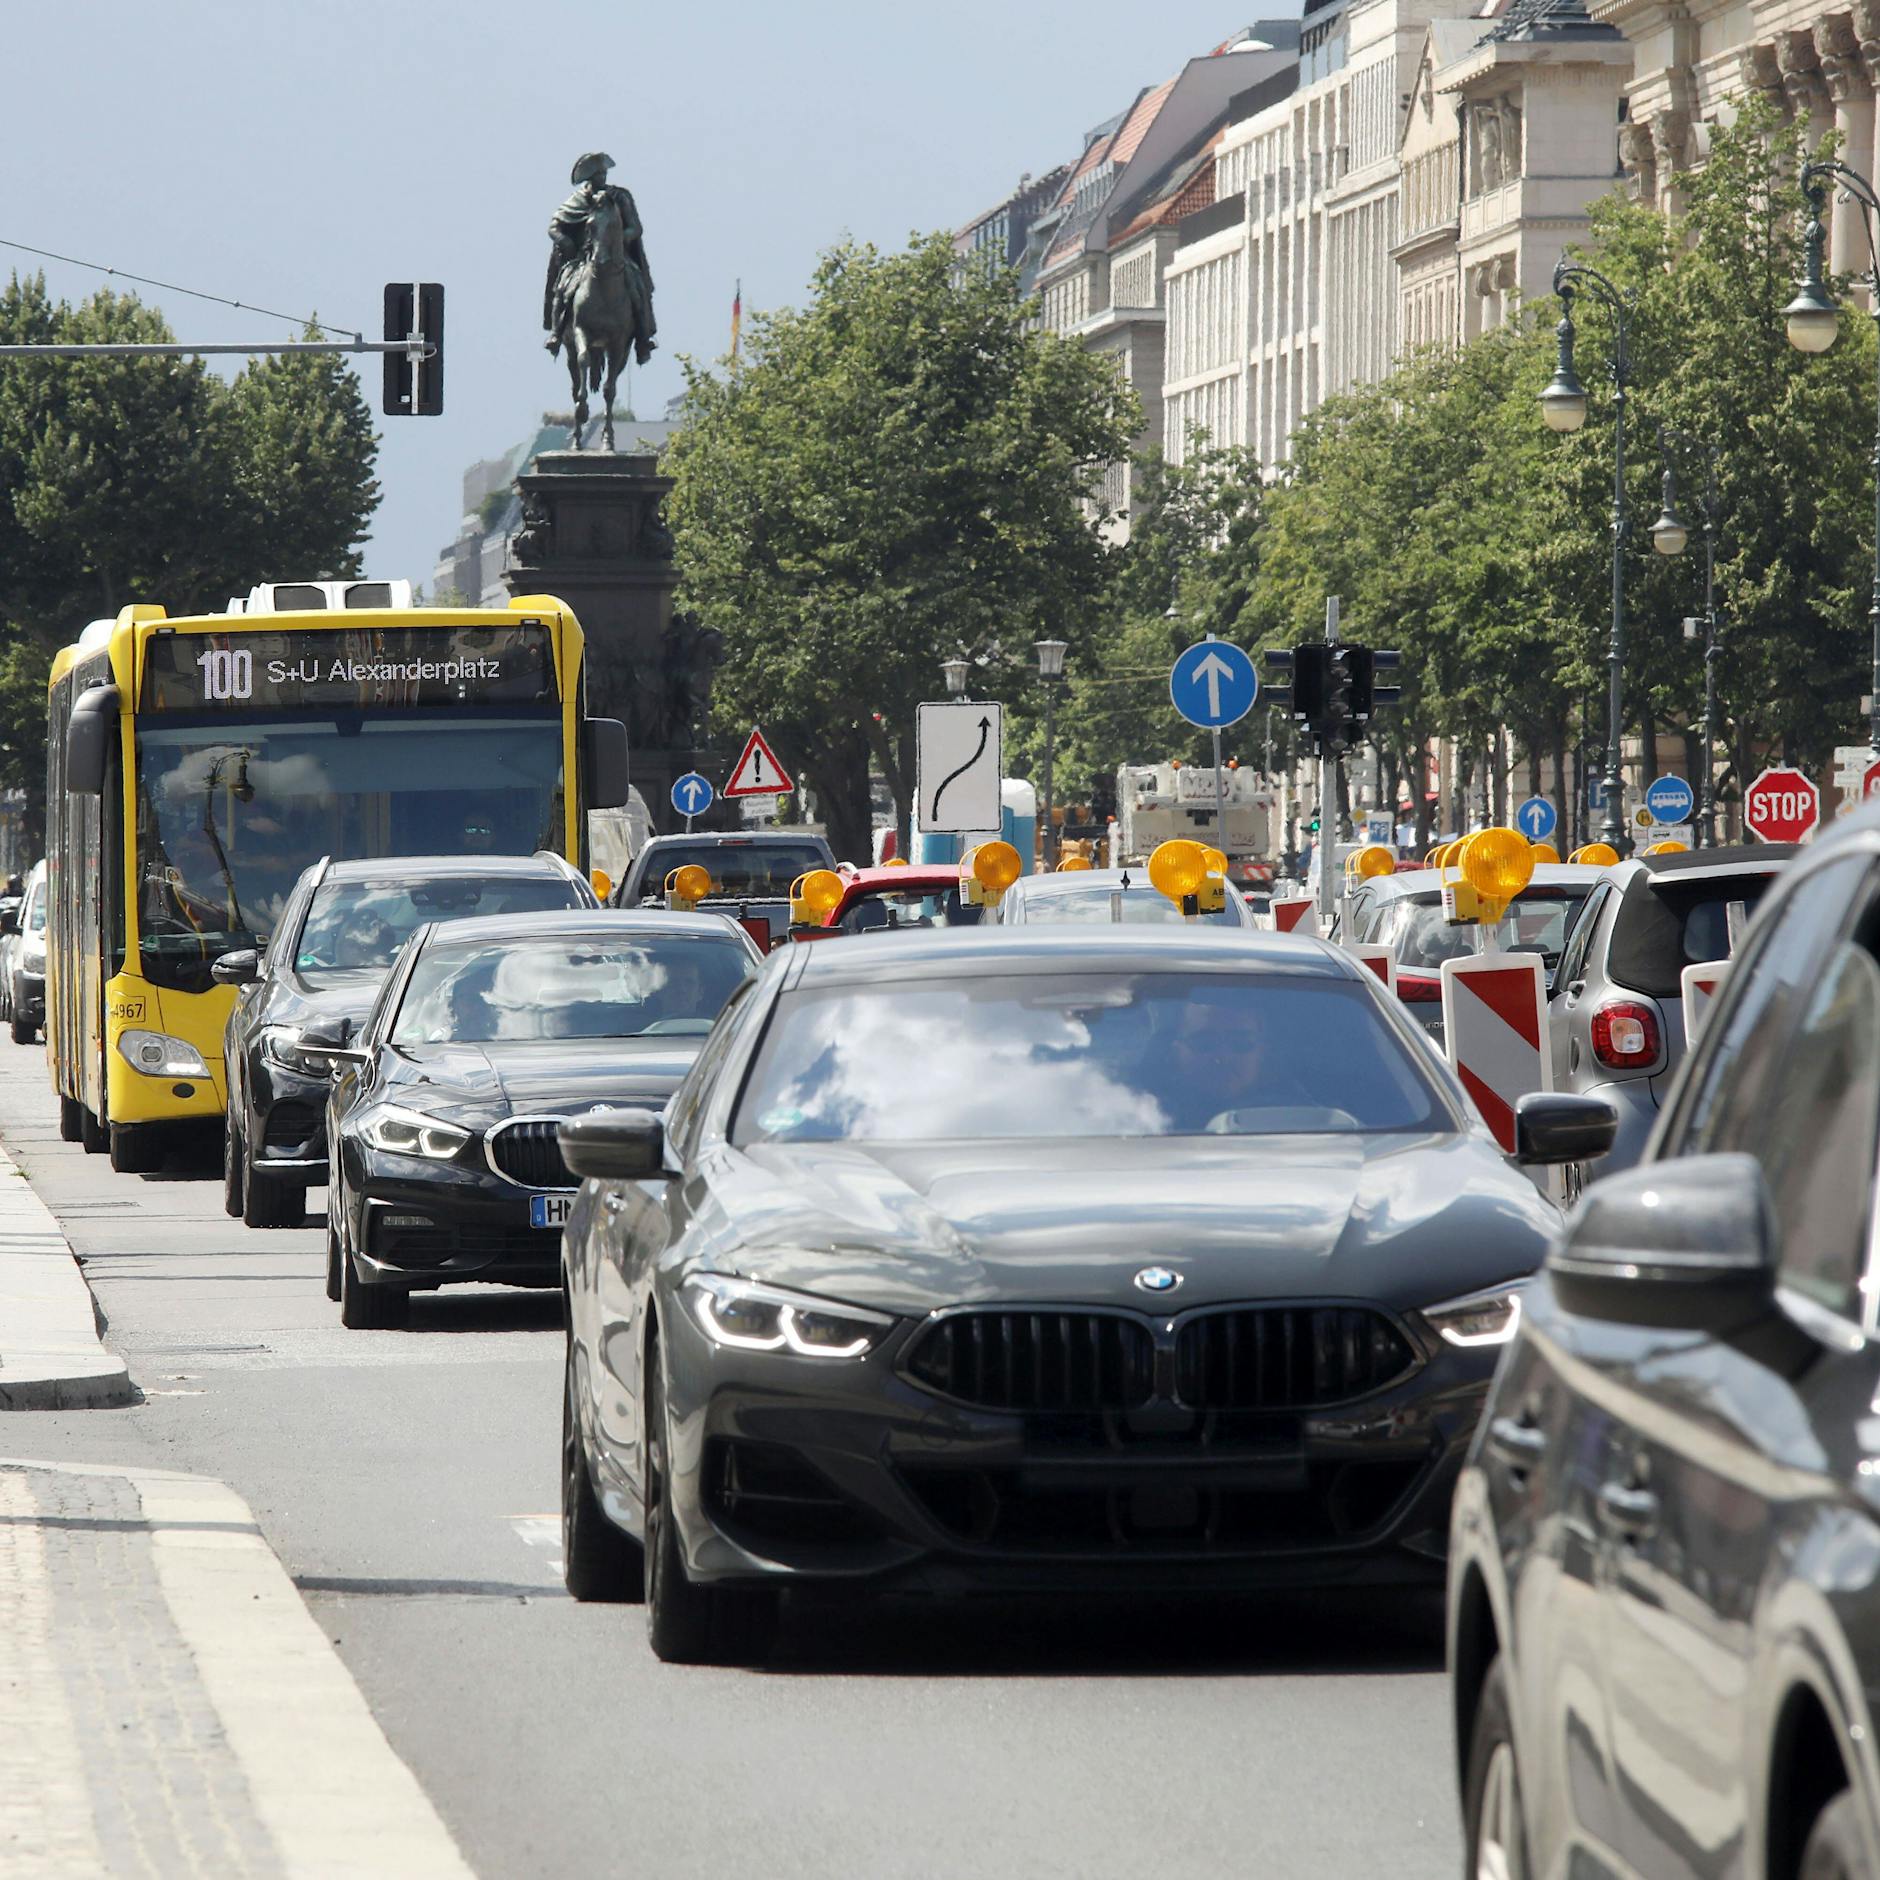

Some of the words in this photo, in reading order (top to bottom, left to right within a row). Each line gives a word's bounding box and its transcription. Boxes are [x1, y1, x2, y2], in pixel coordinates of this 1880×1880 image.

[196, 650, 252, 699] 100
[267, 659, 319, 683] S+U
[328, 656, 500, 684] Alexanderplatz
[1752, 791, 1811, 821] STOP
